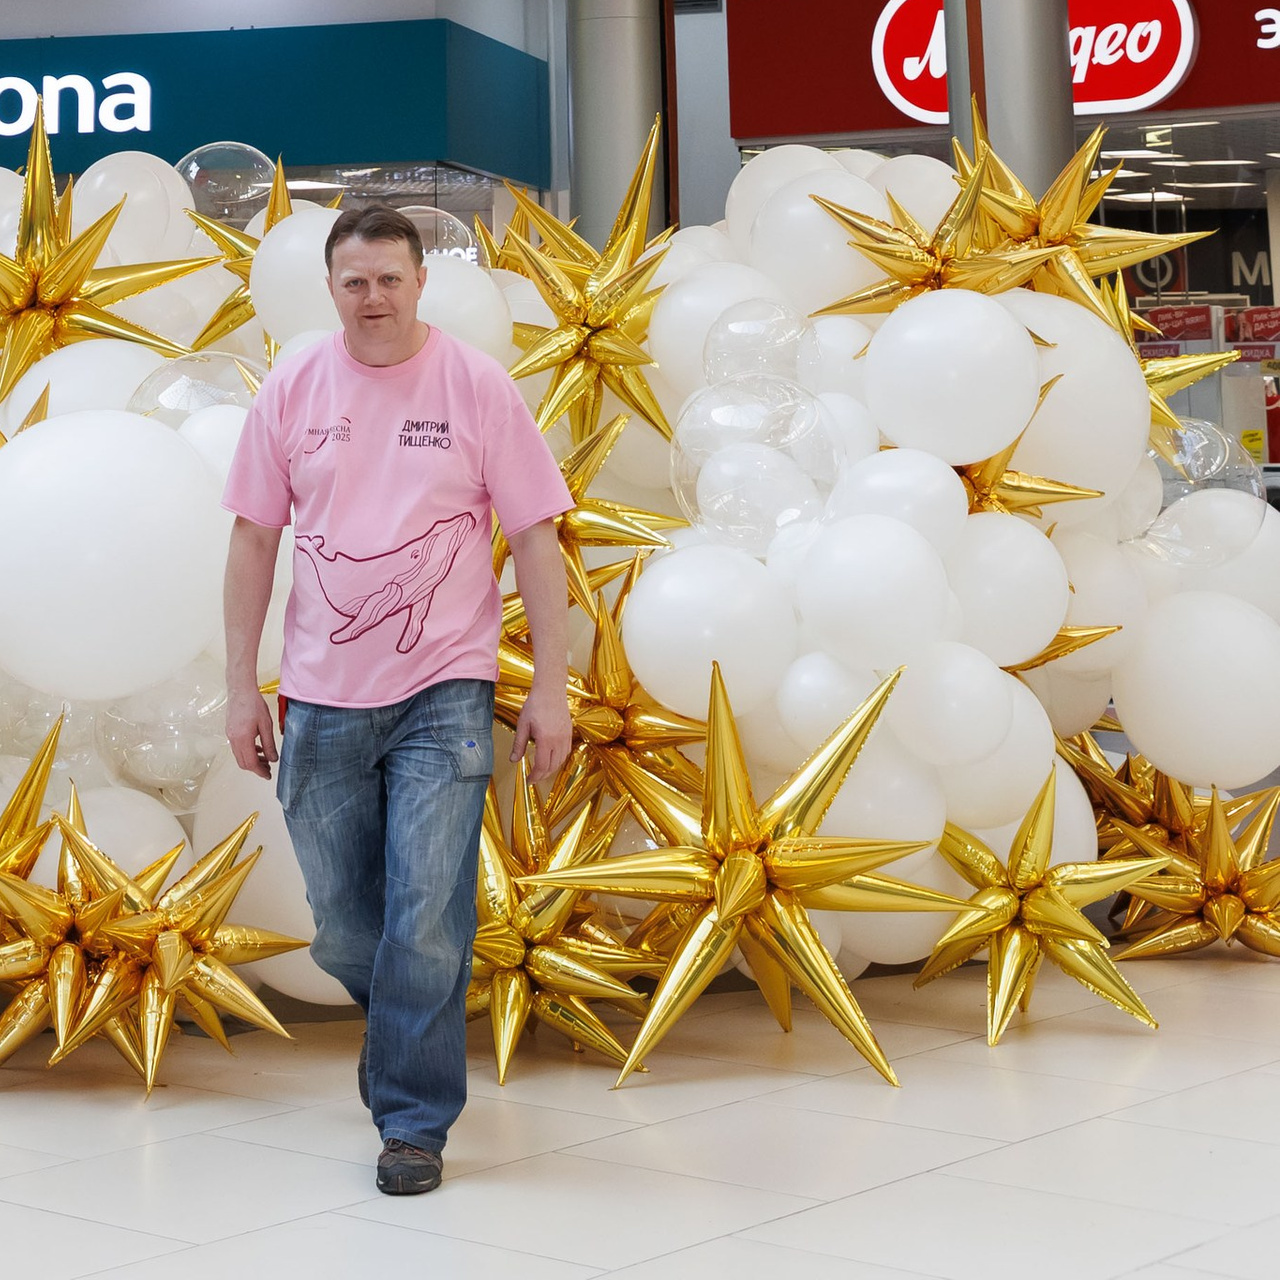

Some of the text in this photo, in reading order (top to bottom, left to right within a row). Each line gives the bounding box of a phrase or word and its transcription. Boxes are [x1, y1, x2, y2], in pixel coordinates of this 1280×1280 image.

[1240, 349, 1272, 359] КИДКА
[402, 420, 449, 434] ДМИТРИЙ
[331, 433, 351, 442] 2025
[398, 435, 451, 450] ТИЩЕНКО
